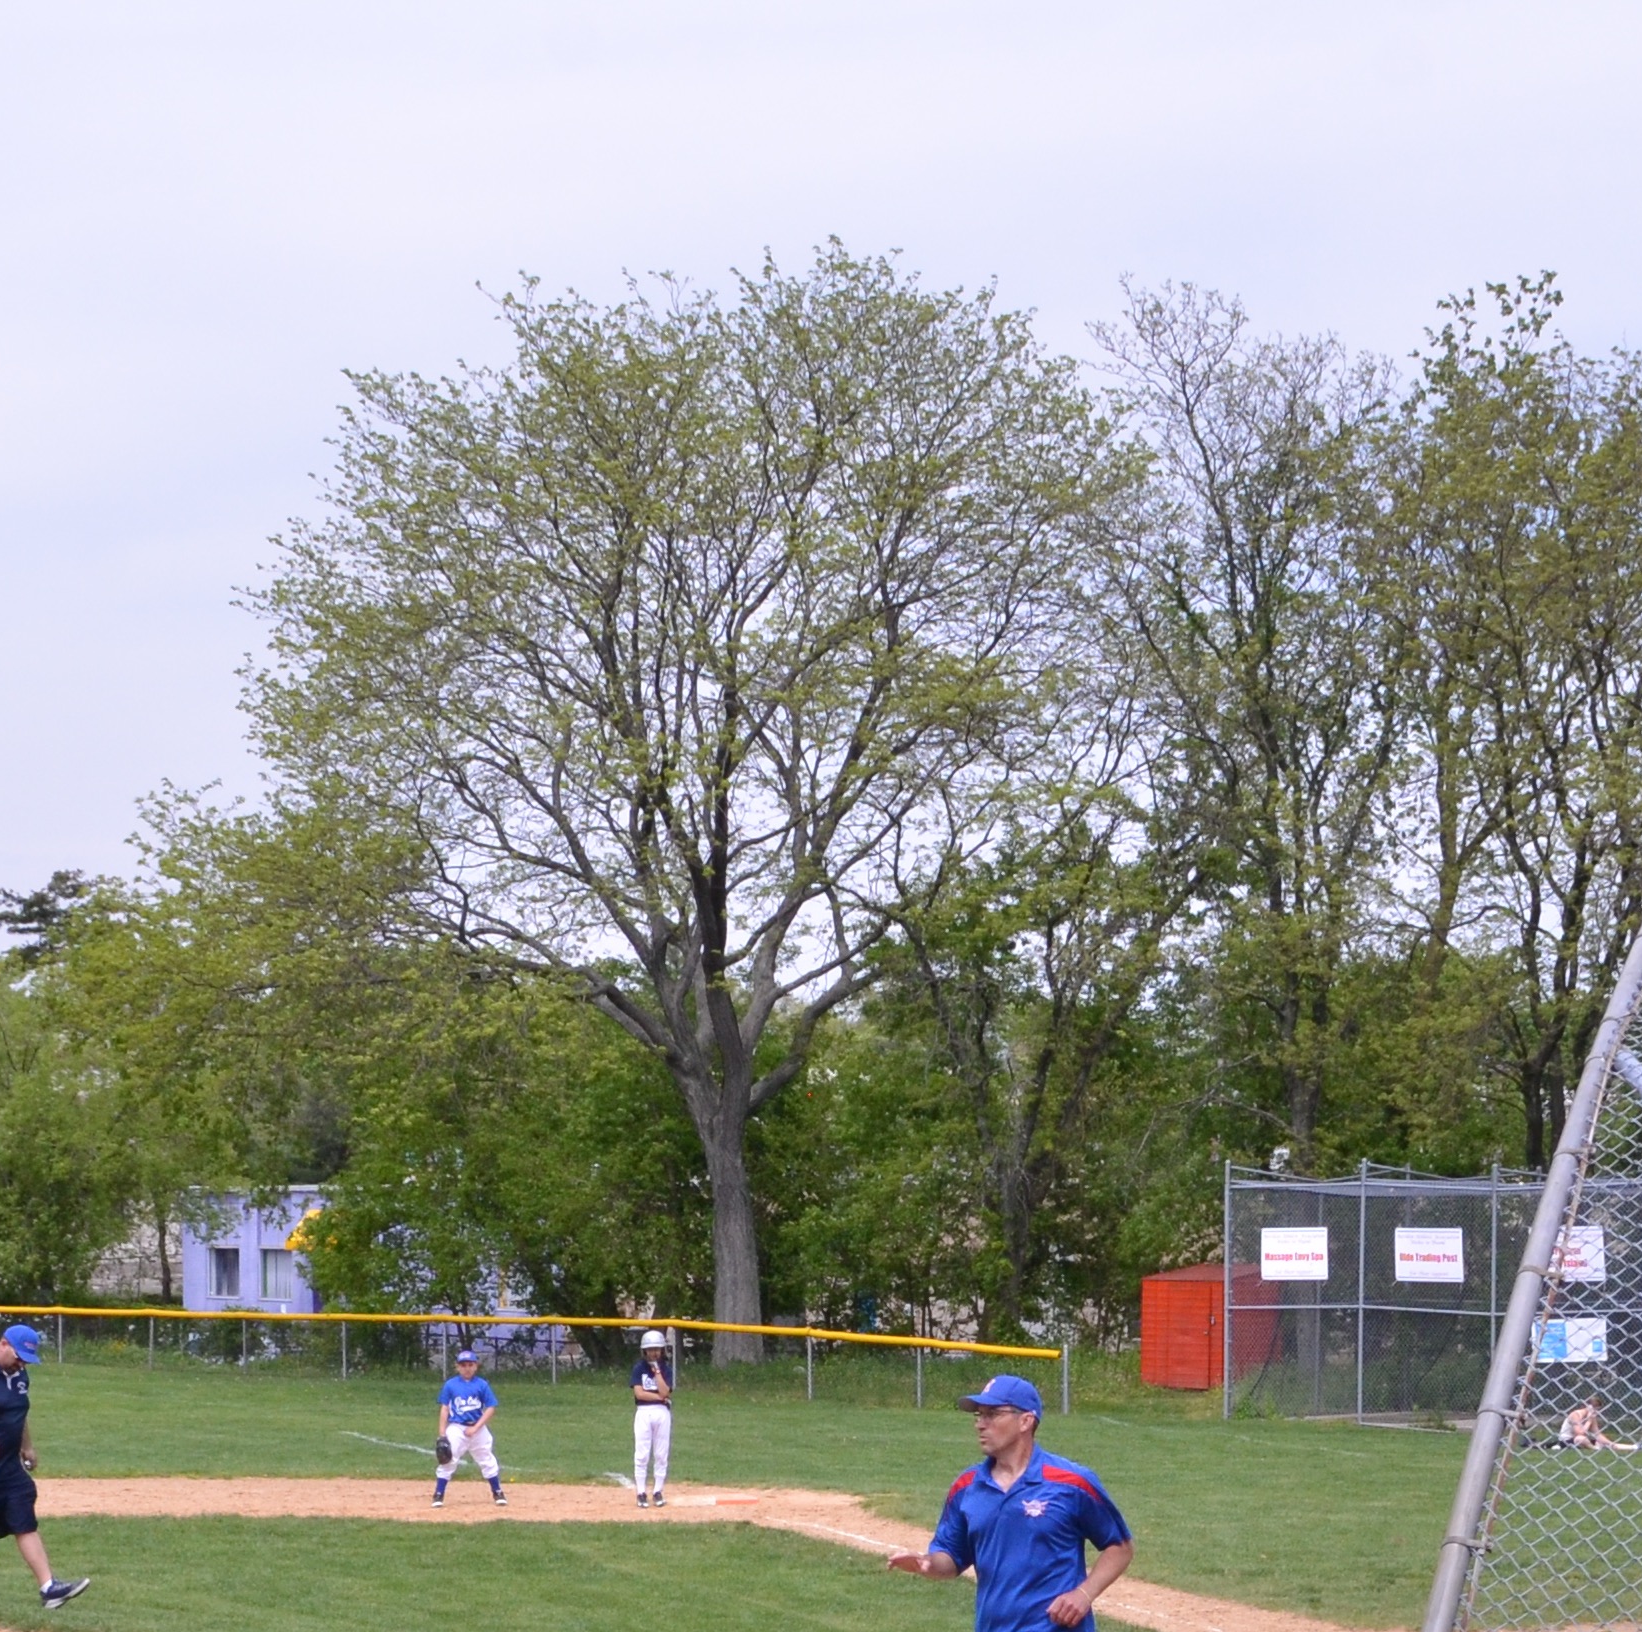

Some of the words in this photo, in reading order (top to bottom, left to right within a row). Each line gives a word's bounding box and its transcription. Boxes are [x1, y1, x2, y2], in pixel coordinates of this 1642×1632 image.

[1264, 1252, 1293, 1262] Massage
[1294, 1252, 1310, 1261] Envy
[1311, 1252, 1324, 1261] Spa
[1415, 1252, 1441, 1263] Trading
[1442, 1253, 1458, 1263] Post
